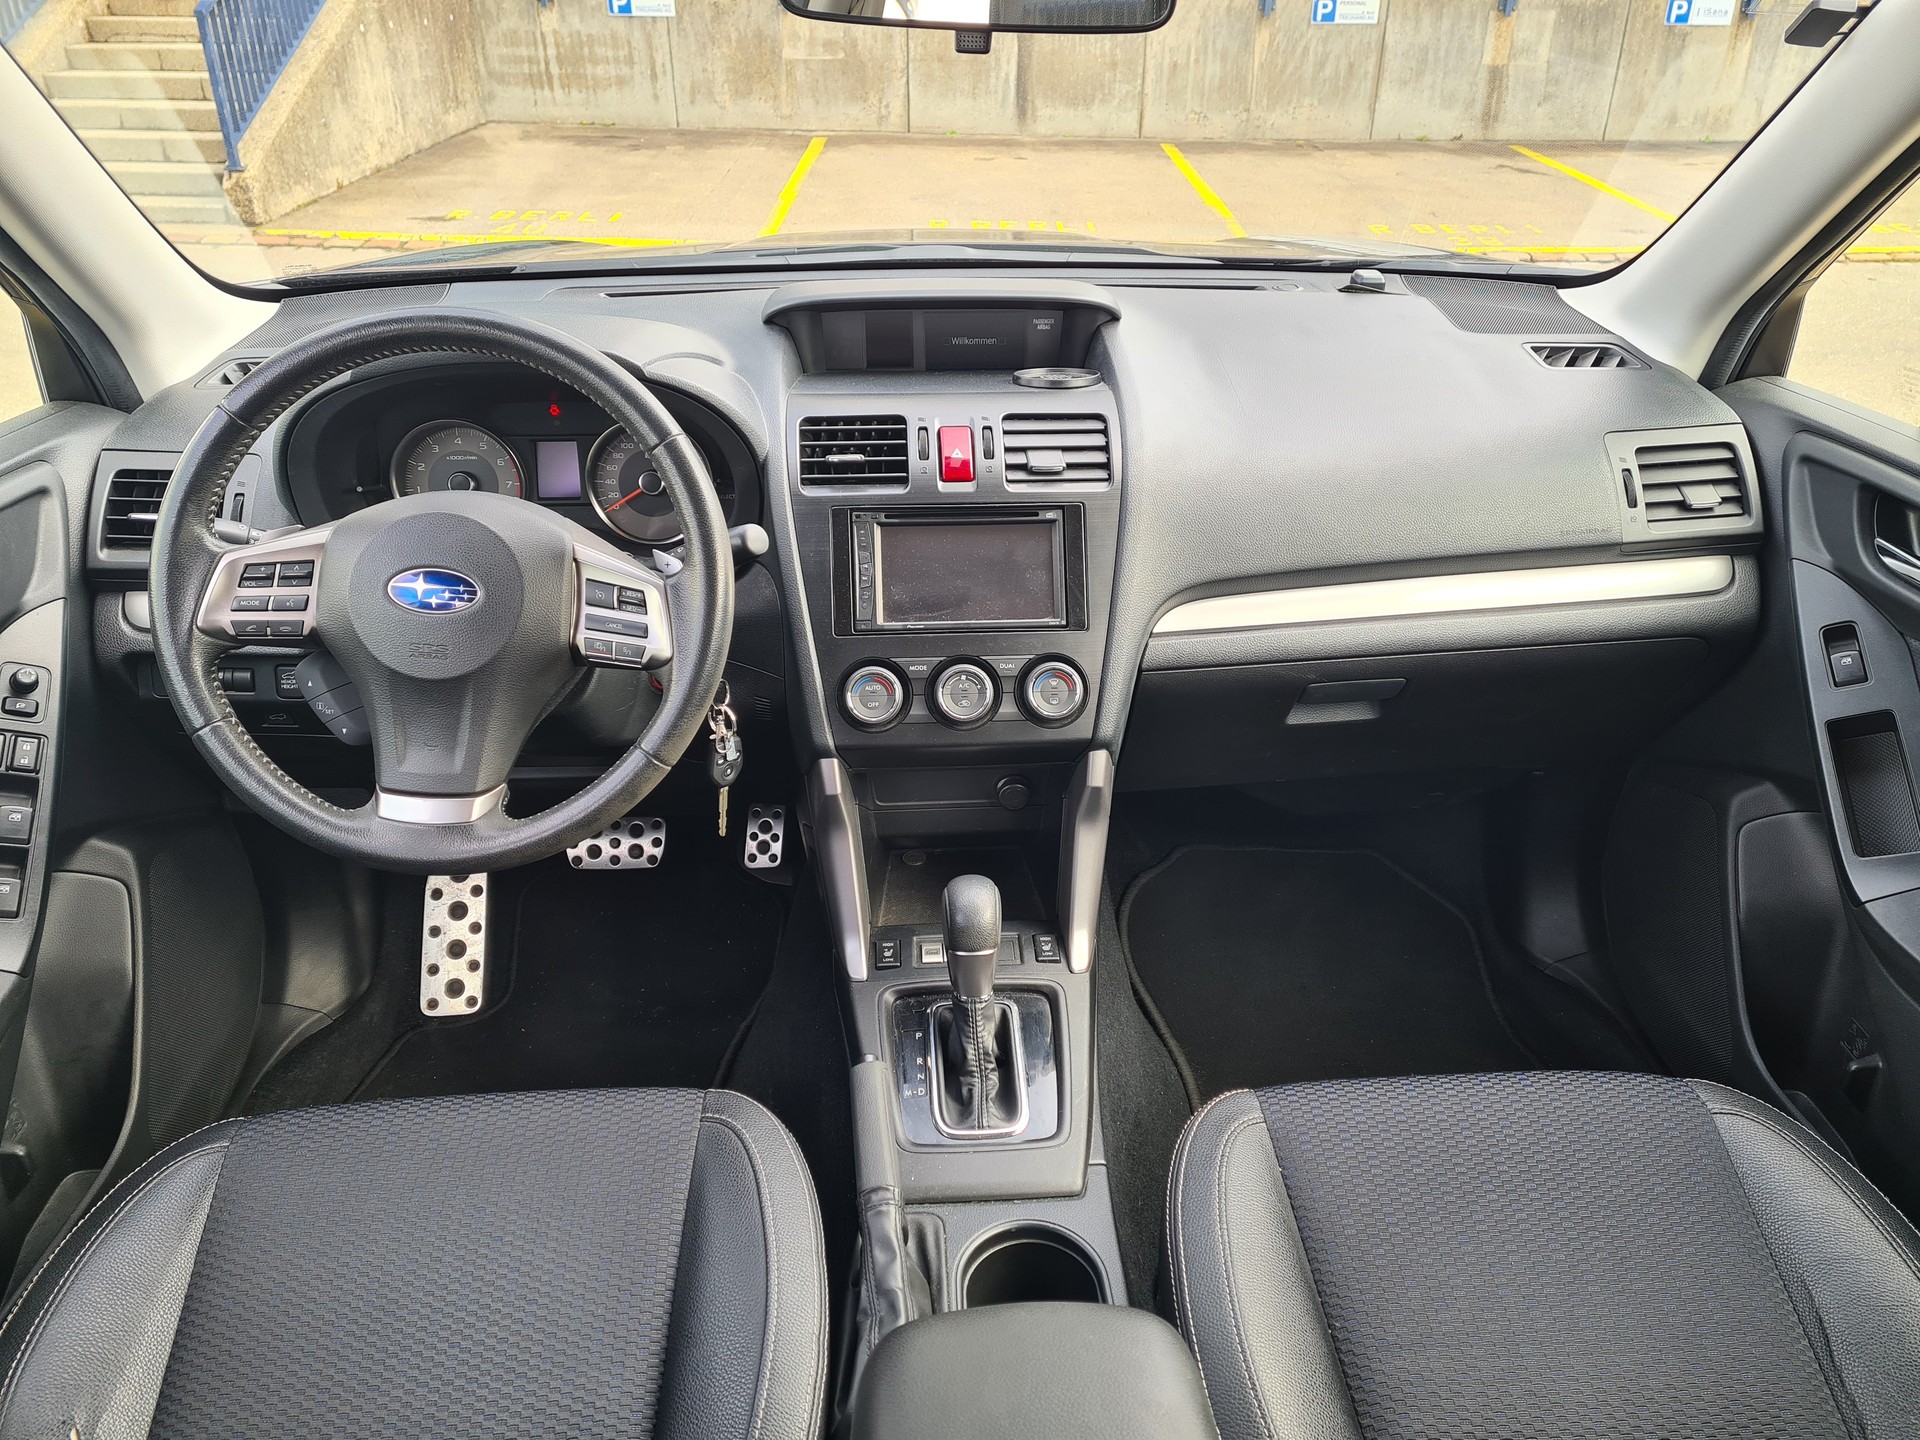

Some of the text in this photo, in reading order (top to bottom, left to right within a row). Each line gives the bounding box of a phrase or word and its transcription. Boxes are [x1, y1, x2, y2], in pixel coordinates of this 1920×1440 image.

[1316, 0, 1334, 21] P
[1669, 0, 1689, 23] P
[951, 337, 997, 345] Willkommen
[496, 458, 504, 466] 6
[605, 622, 623, 630] CANCEL
[915, 1032, 923, 1040] P
[917, 1073, 925, 1081] N
